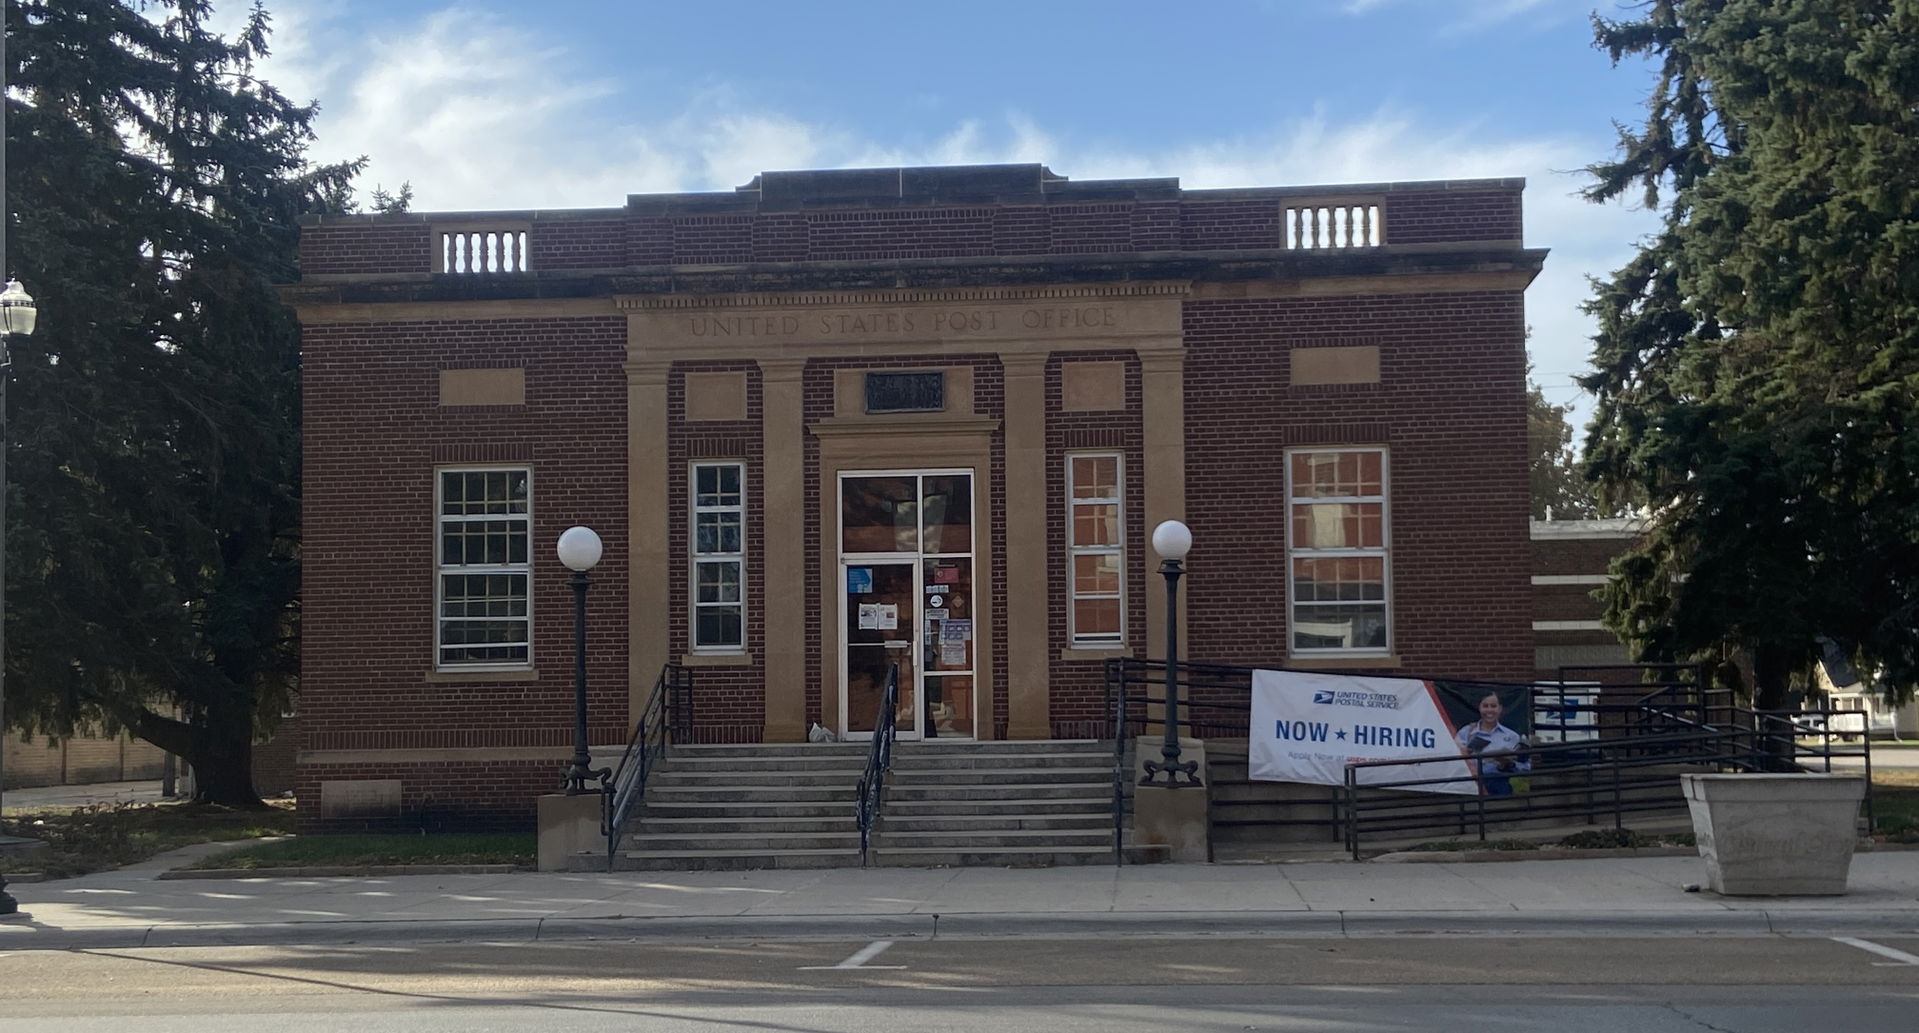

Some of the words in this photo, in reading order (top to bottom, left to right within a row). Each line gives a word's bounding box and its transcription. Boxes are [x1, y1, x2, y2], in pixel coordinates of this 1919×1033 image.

[690, 316, 799, 337] UNITED
[820, 313, 916, 334] STATES
[934, 310, 1001, 331] POST
[1022, 307, 1116, 329] OFFICE
[1337, 691, 1368, 700] UNITED
[1369, 693, 1398, 702] STATES
[1335, 698, 1365, 707] POSTAL
[1366, 700, 1399, 710] SERVICE
[1276, 720, 1329, 743] NOW
[1354, 725, 1436, 749] HIRING
[1288, 751, 1311, 762] Apply
[1314, 753, 1333, 761] Now
